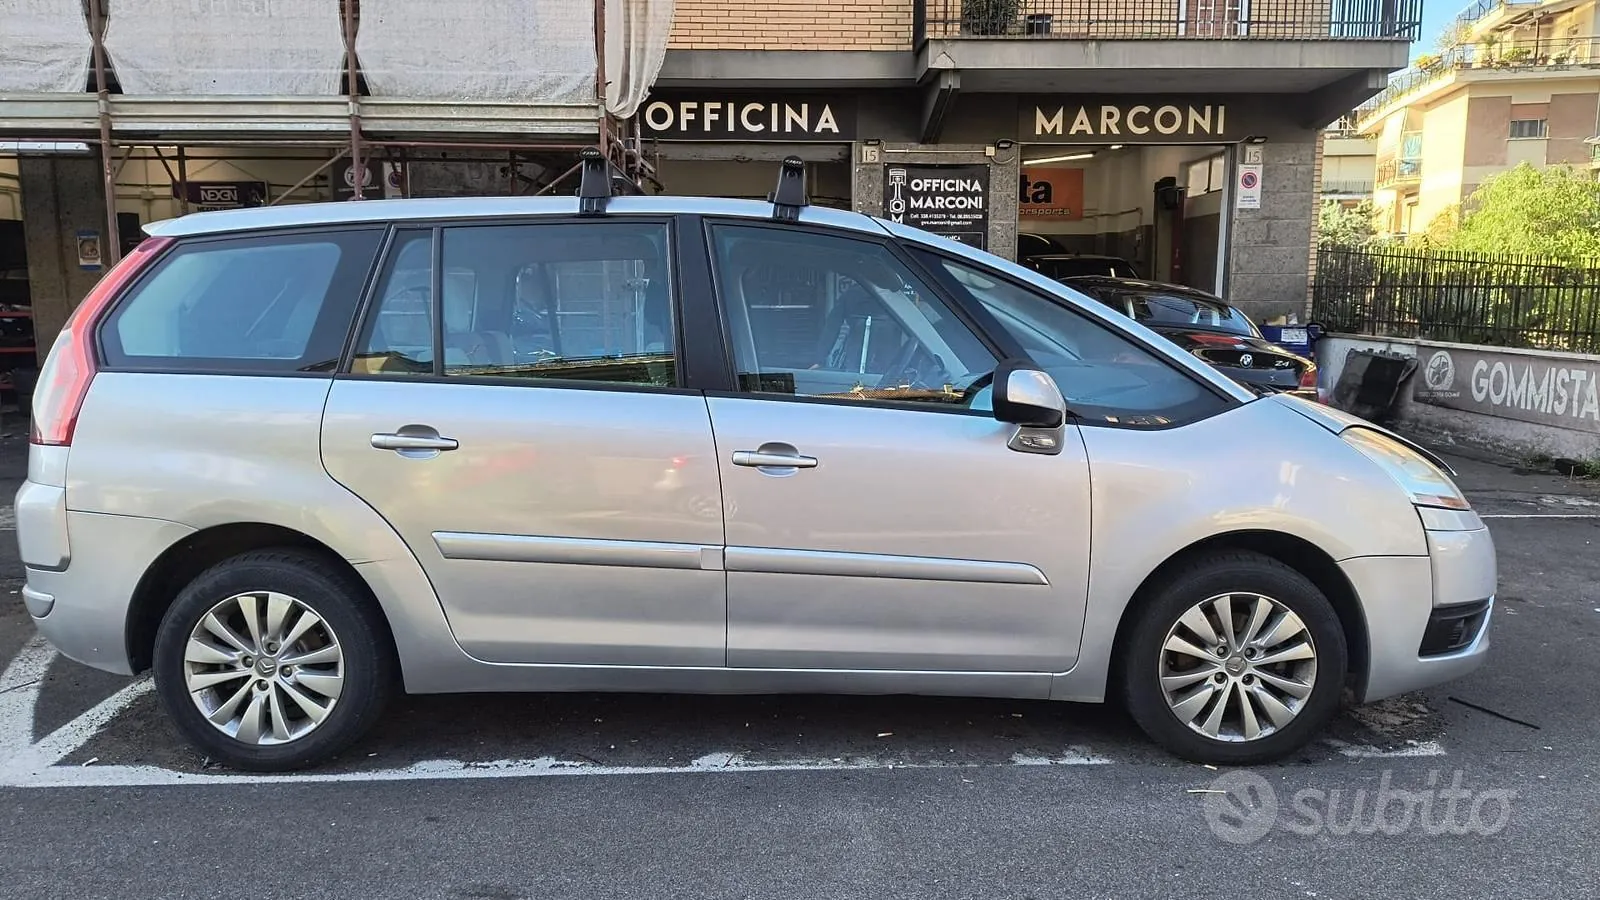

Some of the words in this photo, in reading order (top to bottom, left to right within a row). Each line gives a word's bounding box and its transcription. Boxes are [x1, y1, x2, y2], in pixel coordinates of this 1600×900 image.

[645, 101, 839, 133] OFFICINA
[1035, 105, 1225, 135] MARCONI
[865, 150, 876, 161] 15
[1248, 151, 1260, 162] 15
[910, 179, 983, 192] OFFICINA
[1019, 174, 1053, 205] ta
[200, 189, 238, 201] NEXEN
[910, 196, 983, 209] MARCONI
[1019, 208, 1071, 217] orsports
[1471, 359, 1600, 421] GOMMISTA
